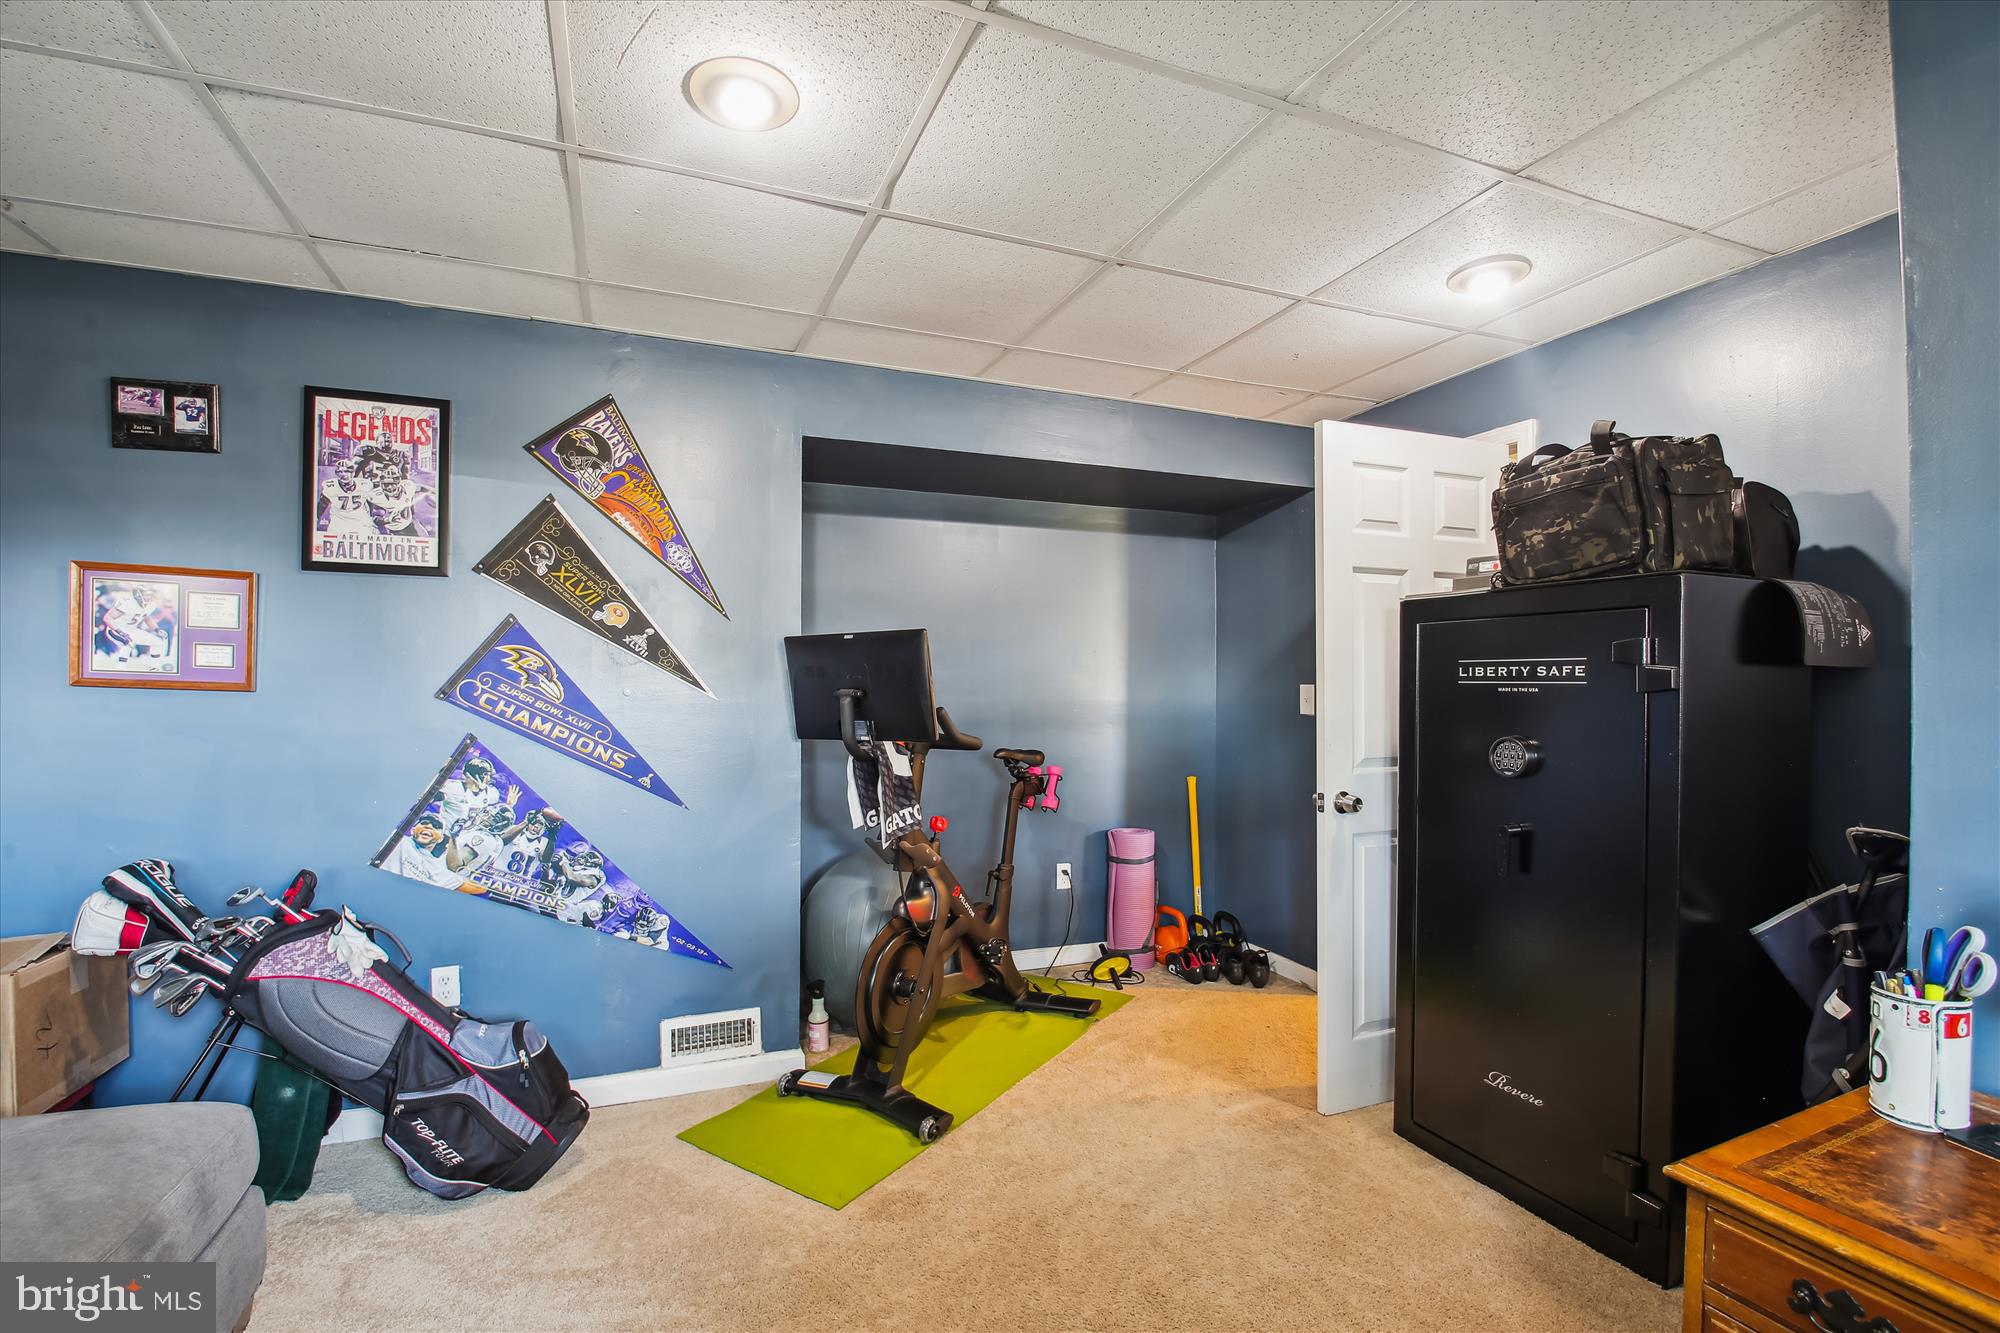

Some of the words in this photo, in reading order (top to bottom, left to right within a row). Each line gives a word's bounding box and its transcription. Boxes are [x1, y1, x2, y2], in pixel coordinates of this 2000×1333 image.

[186, 407, 198, 417] 52
[325, 409, 432, 446] LEGENDS
[579, 410, 634, 468] RAVENS
[605, 405, 639, 456] BALTIMORE
[338, 495, 362, 511] 75
[600, 470, 677, 542] Champions
[322, 540, 430, 563] BALTIMORE
[342, 532, 360, 541] ARE
[367, 535, 393, 543] MADE
[550, 566, 602, 606] XLVII
[563, 561, 587, 583] SUPER
[586, 580, 607, 598] BOWL
[622, 634, 649, 658] XLVII
[1458, 665, 1531, 677] LIBERTY
[1536, 665, 1586, 677] SAFE
[498, 683, 534, 705] SUPER
[534, 699, 564, 719] BOWL
[565, 712, 593, 731] XLVII
[478, 692, 630, 769] CHAMPIONS
[136, 859, 194, 909] ROGUE
[470, 873, 568, 911] CHAMPIONS
[959, 893, 976, 918] PELOTON
[1918, 1009, 1931, 1025] 8
[1483, 1071, 1544, 1107] Revere
[431, 1149, 454, 1168] TOUR
